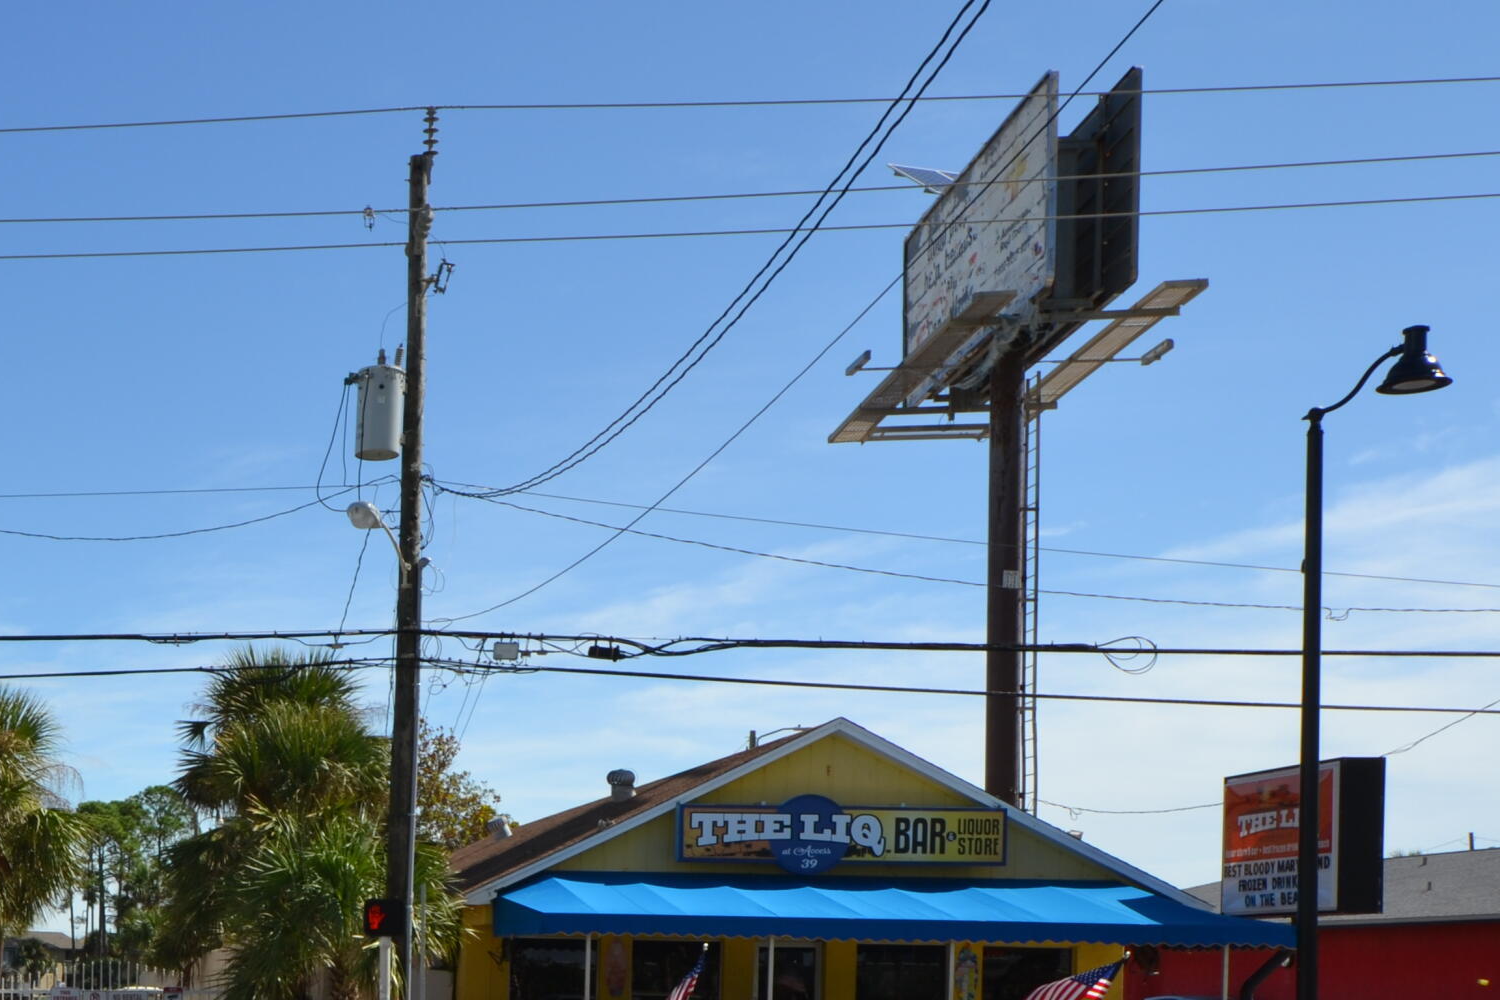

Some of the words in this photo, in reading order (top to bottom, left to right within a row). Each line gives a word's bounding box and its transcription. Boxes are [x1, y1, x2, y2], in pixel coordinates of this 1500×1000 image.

[957, 818, 1000, 836] LIQUOR
[1237, 811, 1277, 838] THE
[1279, 808, 1300, 829] LI
[691, 812, 792, 847] THE
[800, 813, 886, 857] LIQ
[894, 817, 946, 854] BAR
[957, 837, 1000, 856] STORE
[801, 858, 818, 869] 39
[1224, 864, 1242, 878] BEST
[1244, 860, 1275, 876] BLOODY
[1316, 855, 1331, 870] ND
[1238, 878, 1268, 892] FROZEN
[1271, 875, 1300, 890] DRINK
[1245, 894, 1257, 908] ON
[1260, 892, 1276, 907] THE
[1280, 891, 1299, 906] BEA
